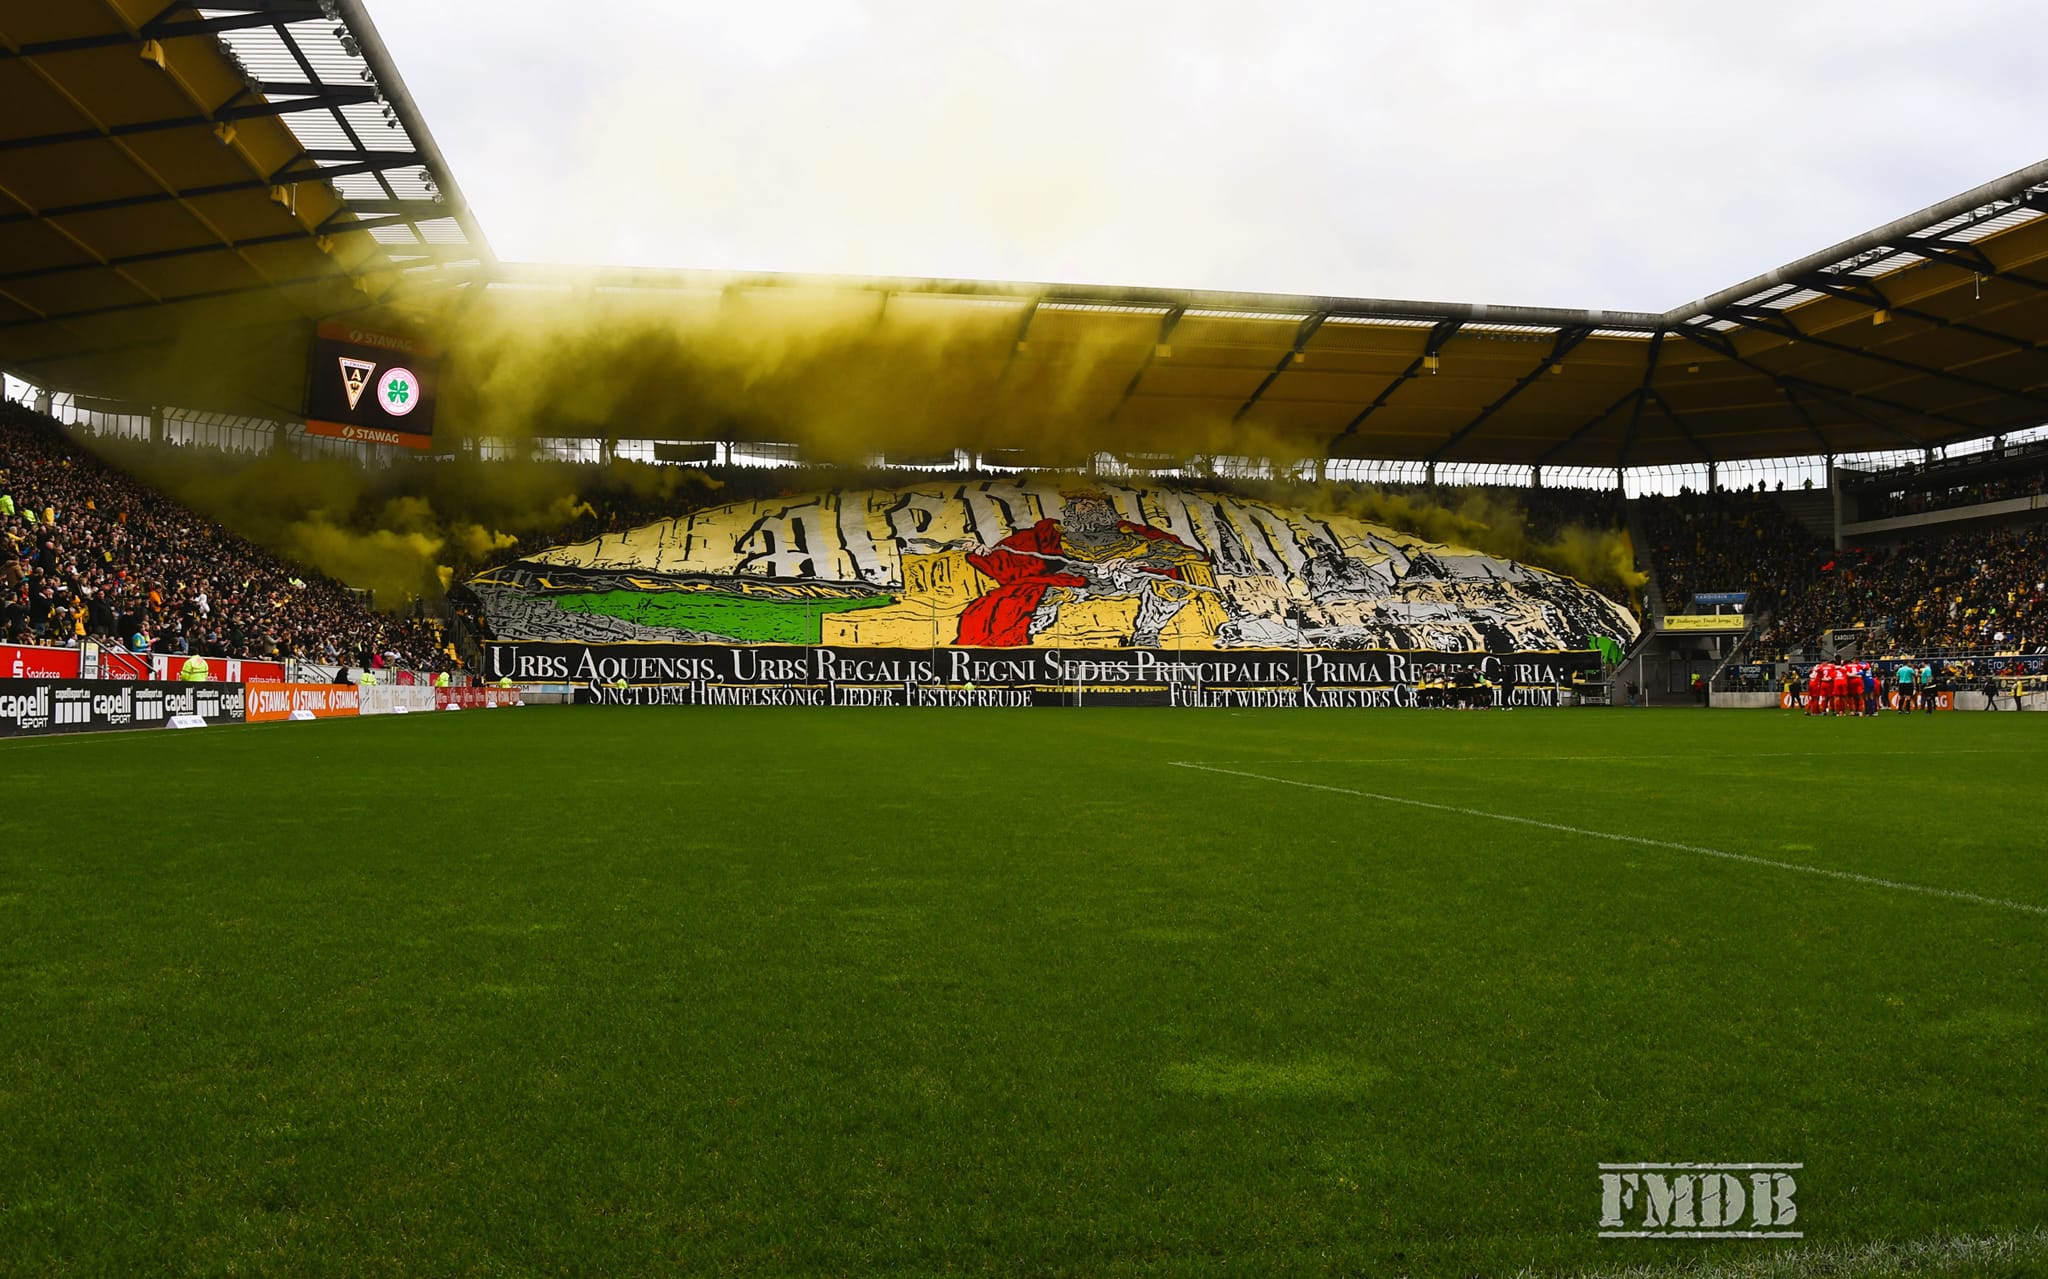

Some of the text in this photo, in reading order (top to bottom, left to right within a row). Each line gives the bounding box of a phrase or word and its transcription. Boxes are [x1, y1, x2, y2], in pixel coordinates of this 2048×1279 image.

[365, 332, 413, 351] STAWAG
[350, 368, 362, 381] A
[356, 428, 400, 444] STAWAG
[0, 686, 49, 726] capelli
[93, 687, 132, 722] capelli
[165, 687, 194, 716] capelli
[220, 688, 245, 716] capelli
[259, 690, 291, 714] STAWAG
[300, 690, 327, 711] STAWAG
[335, 690, 359, 710] STAWAG
[22, 717, 48, 729] SPORT
[111, 714, 132, 725] SPORT
